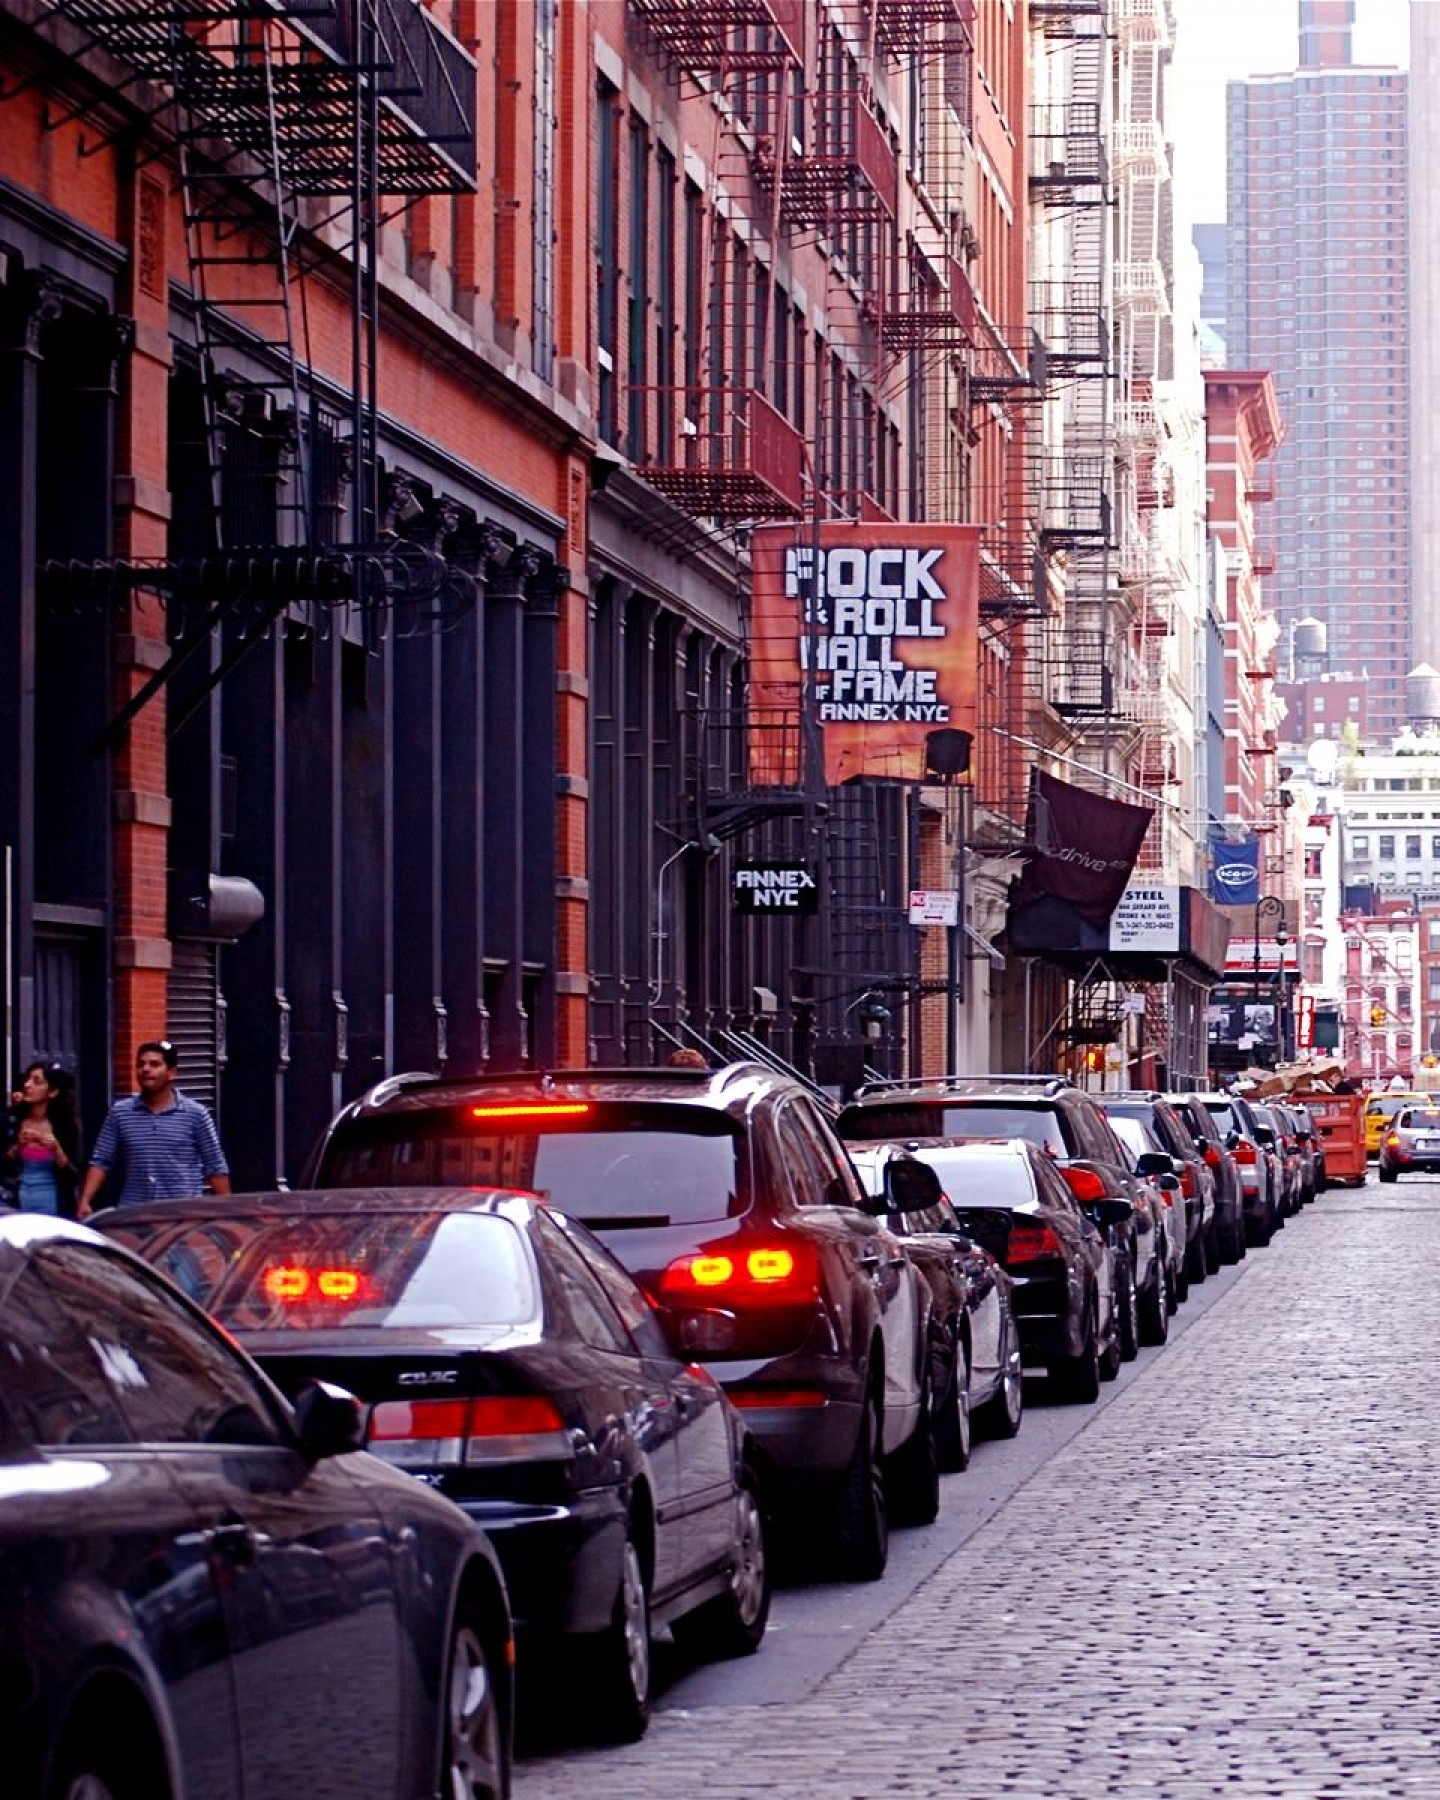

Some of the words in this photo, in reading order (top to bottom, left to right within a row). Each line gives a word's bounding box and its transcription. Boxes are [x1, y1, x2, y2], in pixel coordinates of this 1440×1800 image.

[785, 548, 946, 599] ROCK
[834, 598, 946, 636] ROLL
[800, 635, 904, 671] HALL
[833, 670, 937, 703] FAME
[820, 703, 899, 721] ANNEX
[905, 704, 950, 722] NYC
[735, 870, 816, 889] ANNEX
[752, 888, 800, 907] NYC
[1124, 890, 1165, 901] STEEL
